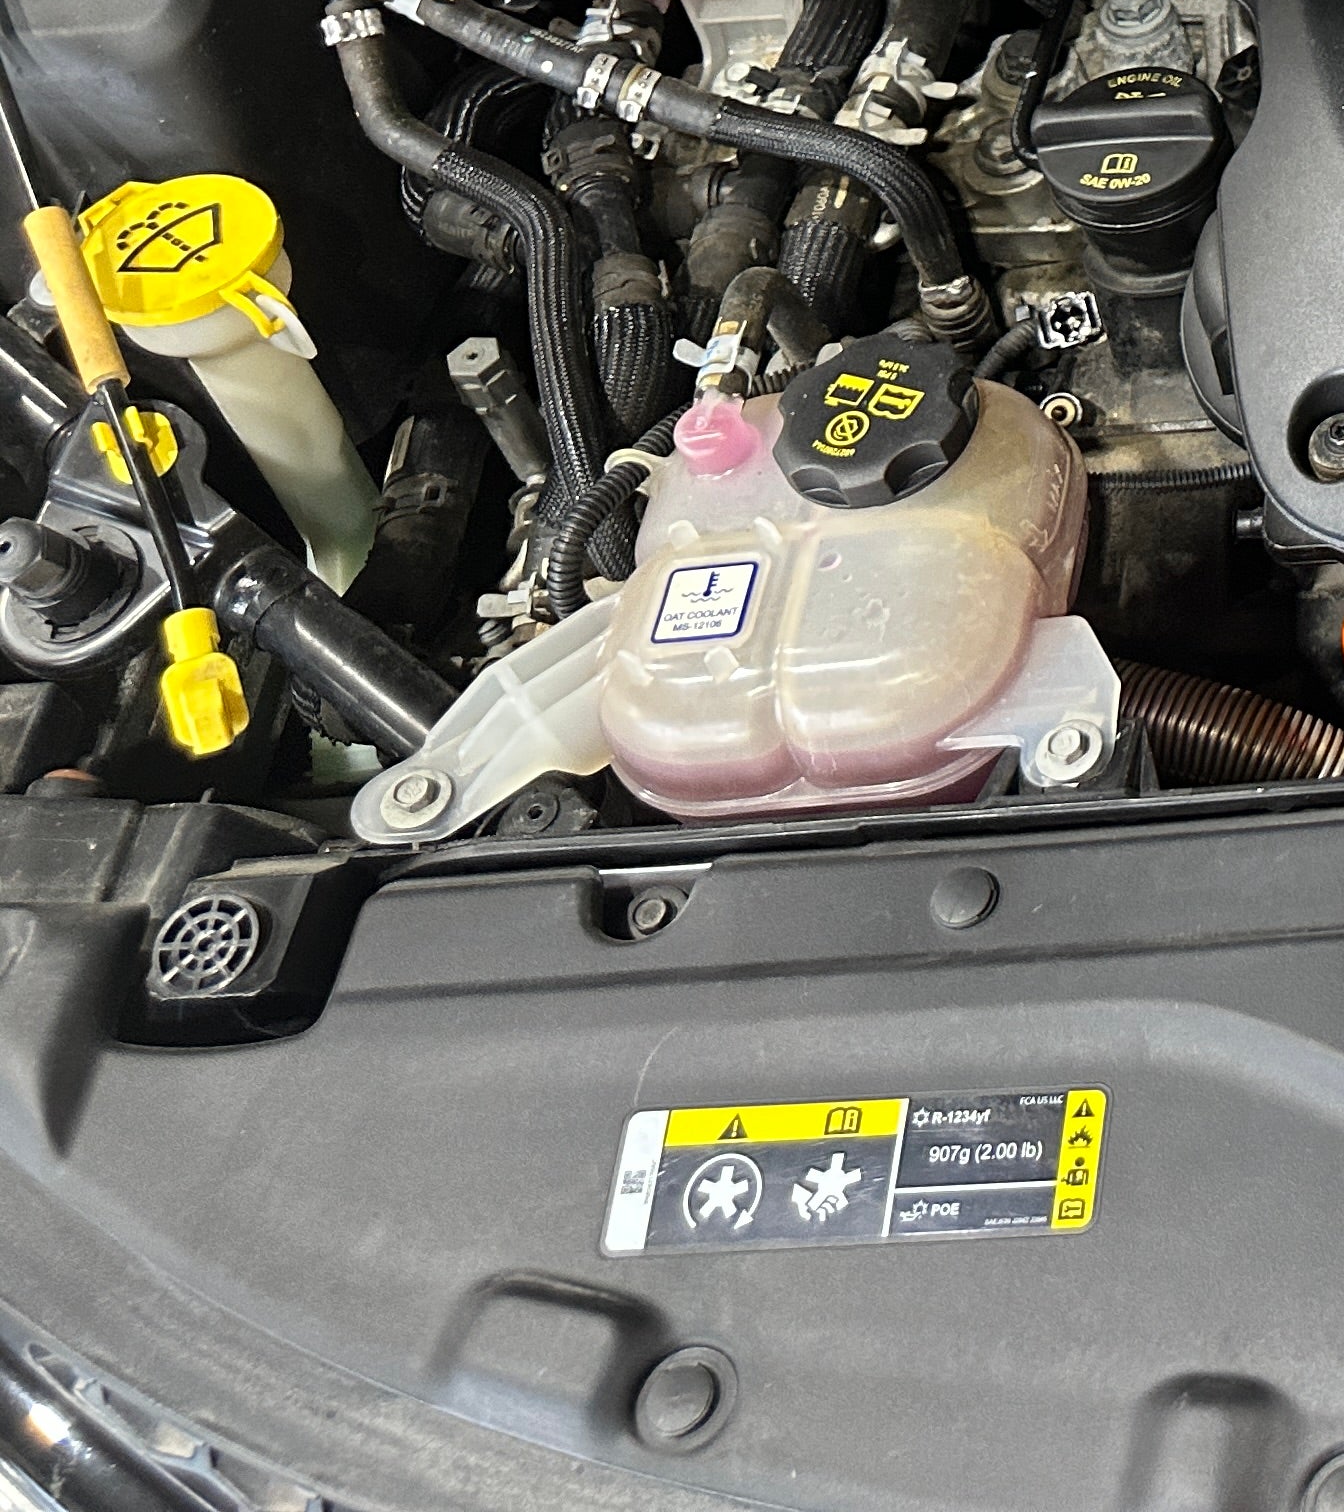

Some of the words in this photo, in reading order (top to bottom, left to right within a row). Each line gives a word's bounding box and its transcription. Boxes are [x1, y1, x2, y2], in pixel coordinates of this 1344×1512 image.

[1107, 71, 1162, 89] ENGINE
[1079, 173, 1107, 190] SAE
[1108, 172, 1152, 190] 0W-20
[663, 612, 686, 622] OAT
[686, 606, 739, 620] COOLANT
[931, 1108, 991, 1126] R-1234yf
[928, 1142, 971, 1165] 907g
[974, 1141, 1018, 1164] (2.00
[1019, 1141, 1044, 1162] lb)
[930, 1201, 960, 1218] POE
